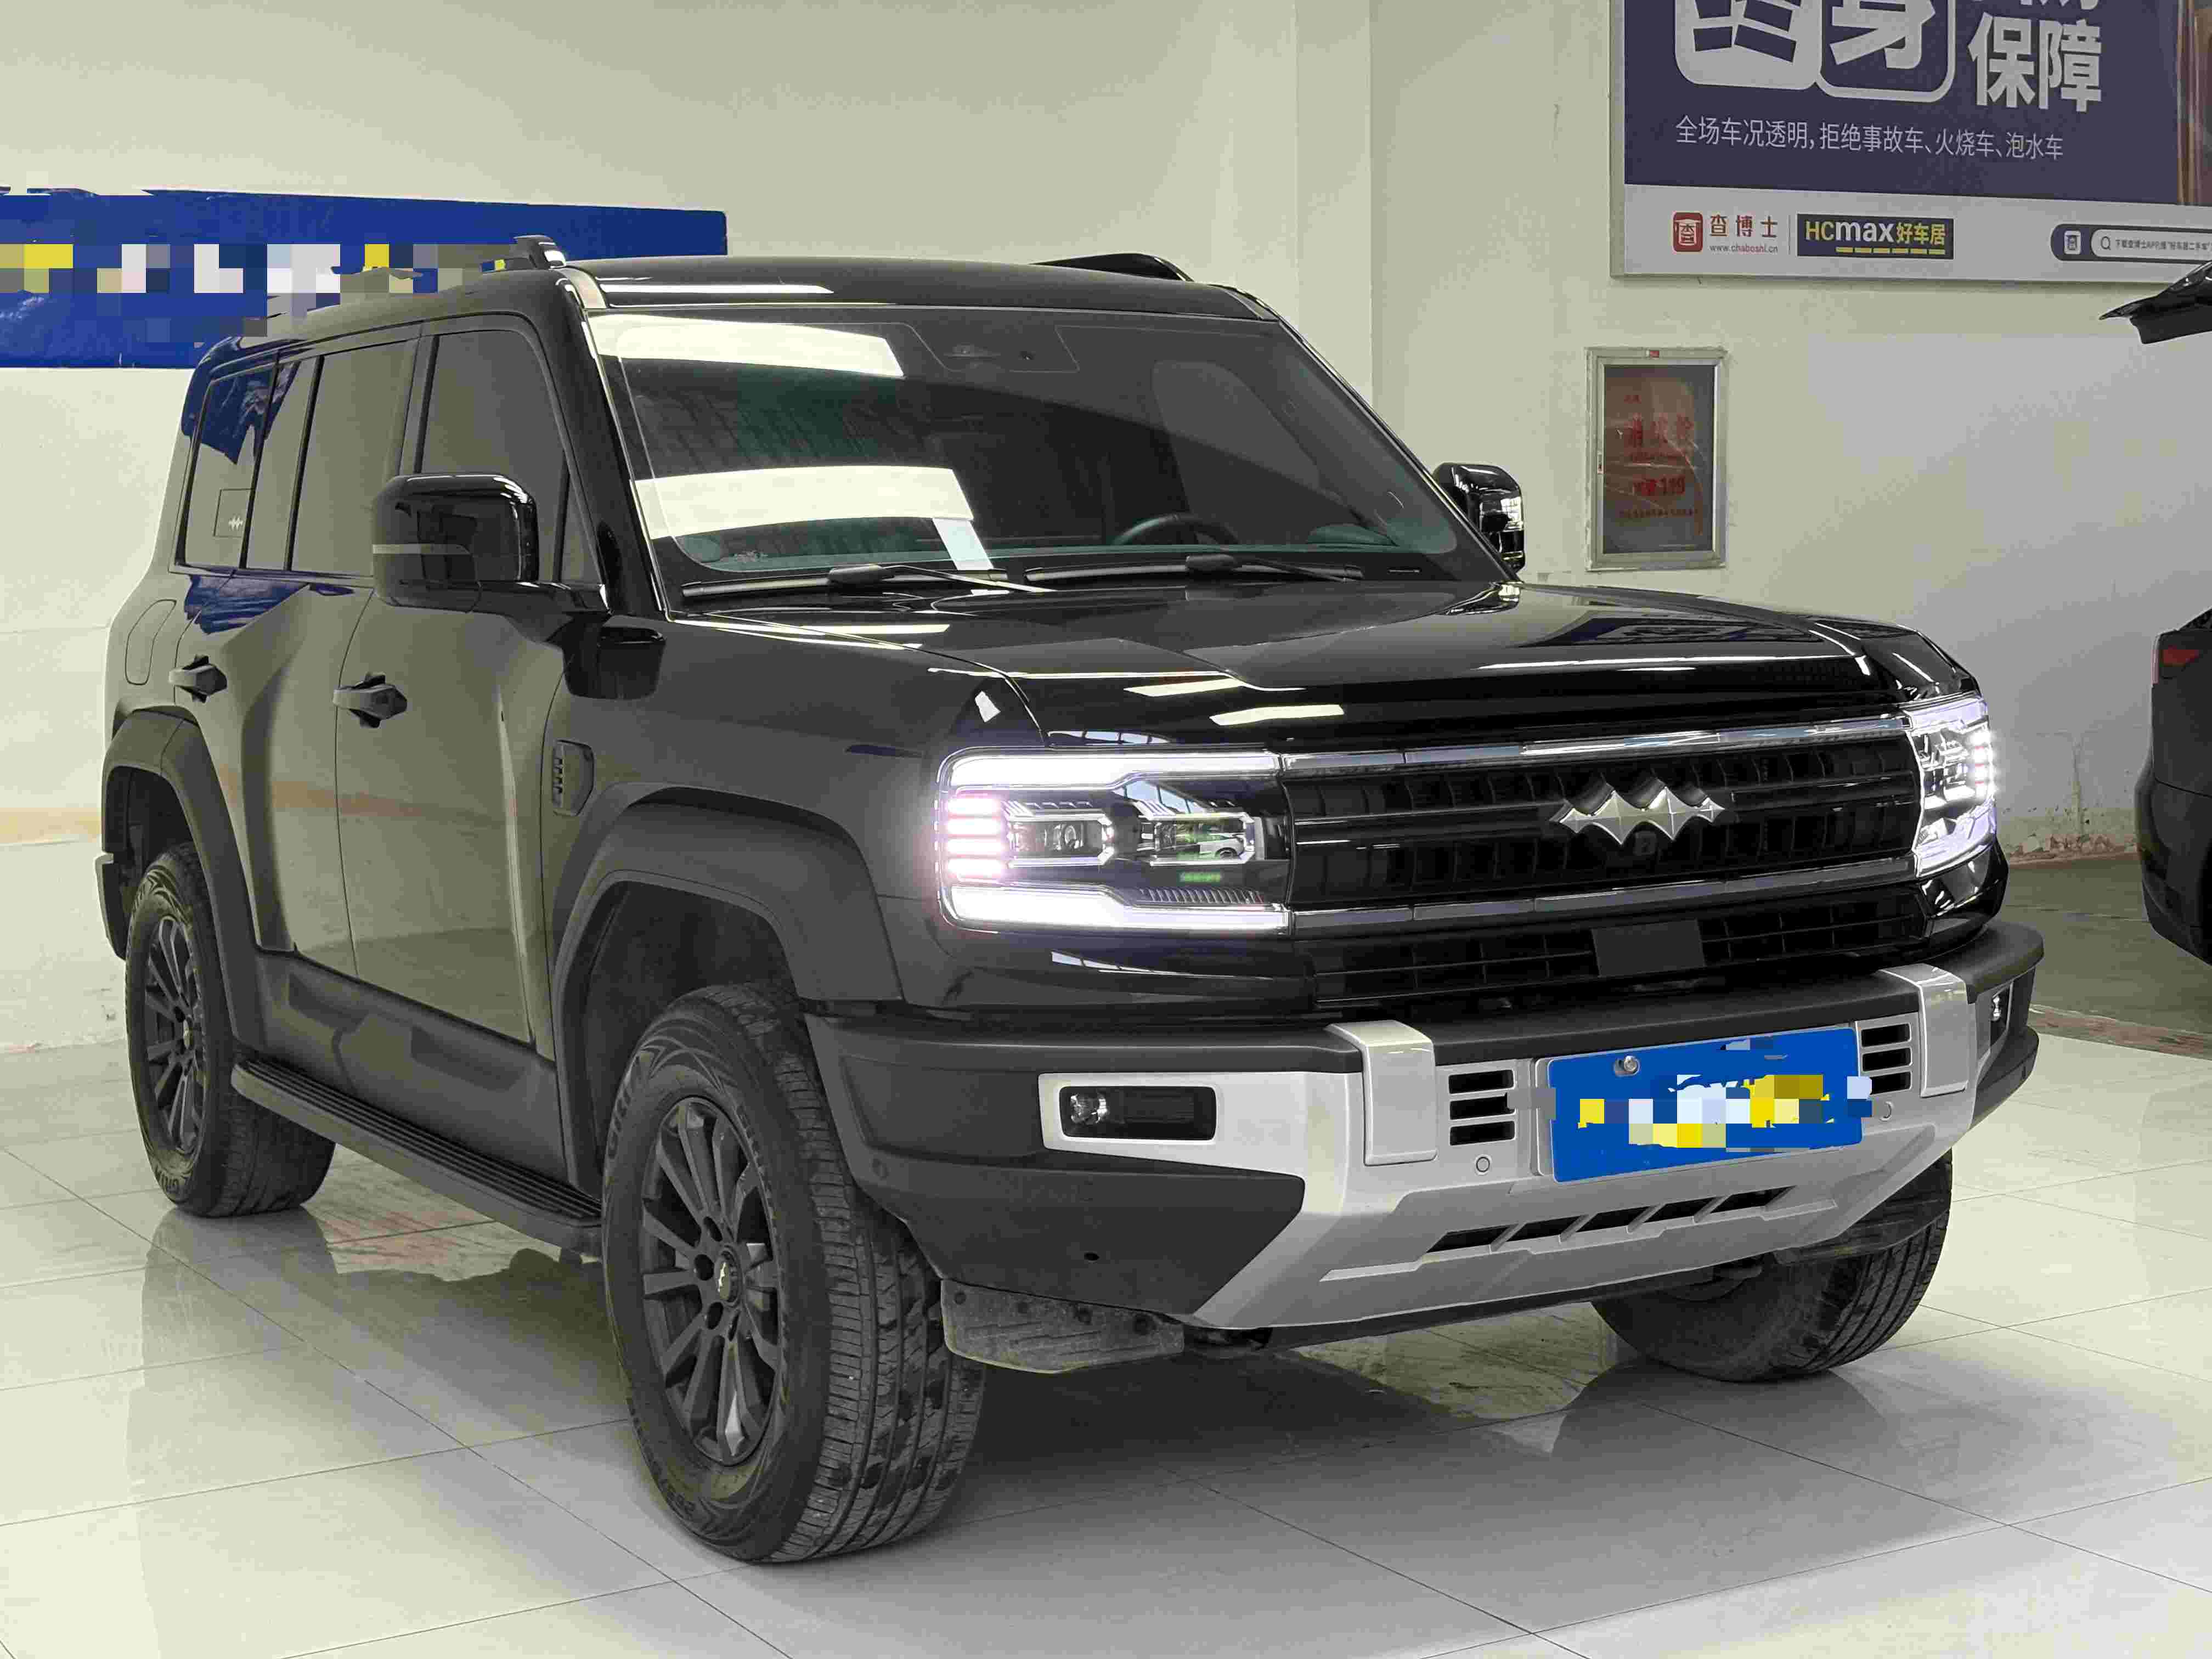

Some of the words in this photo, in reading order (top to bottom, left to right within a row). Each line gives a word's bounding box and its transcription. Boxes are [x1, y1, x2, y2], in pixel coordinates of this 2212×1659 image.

[1967, 12, 2102, 112] 保障
[1709, 213, 1778, 238] 查博士
